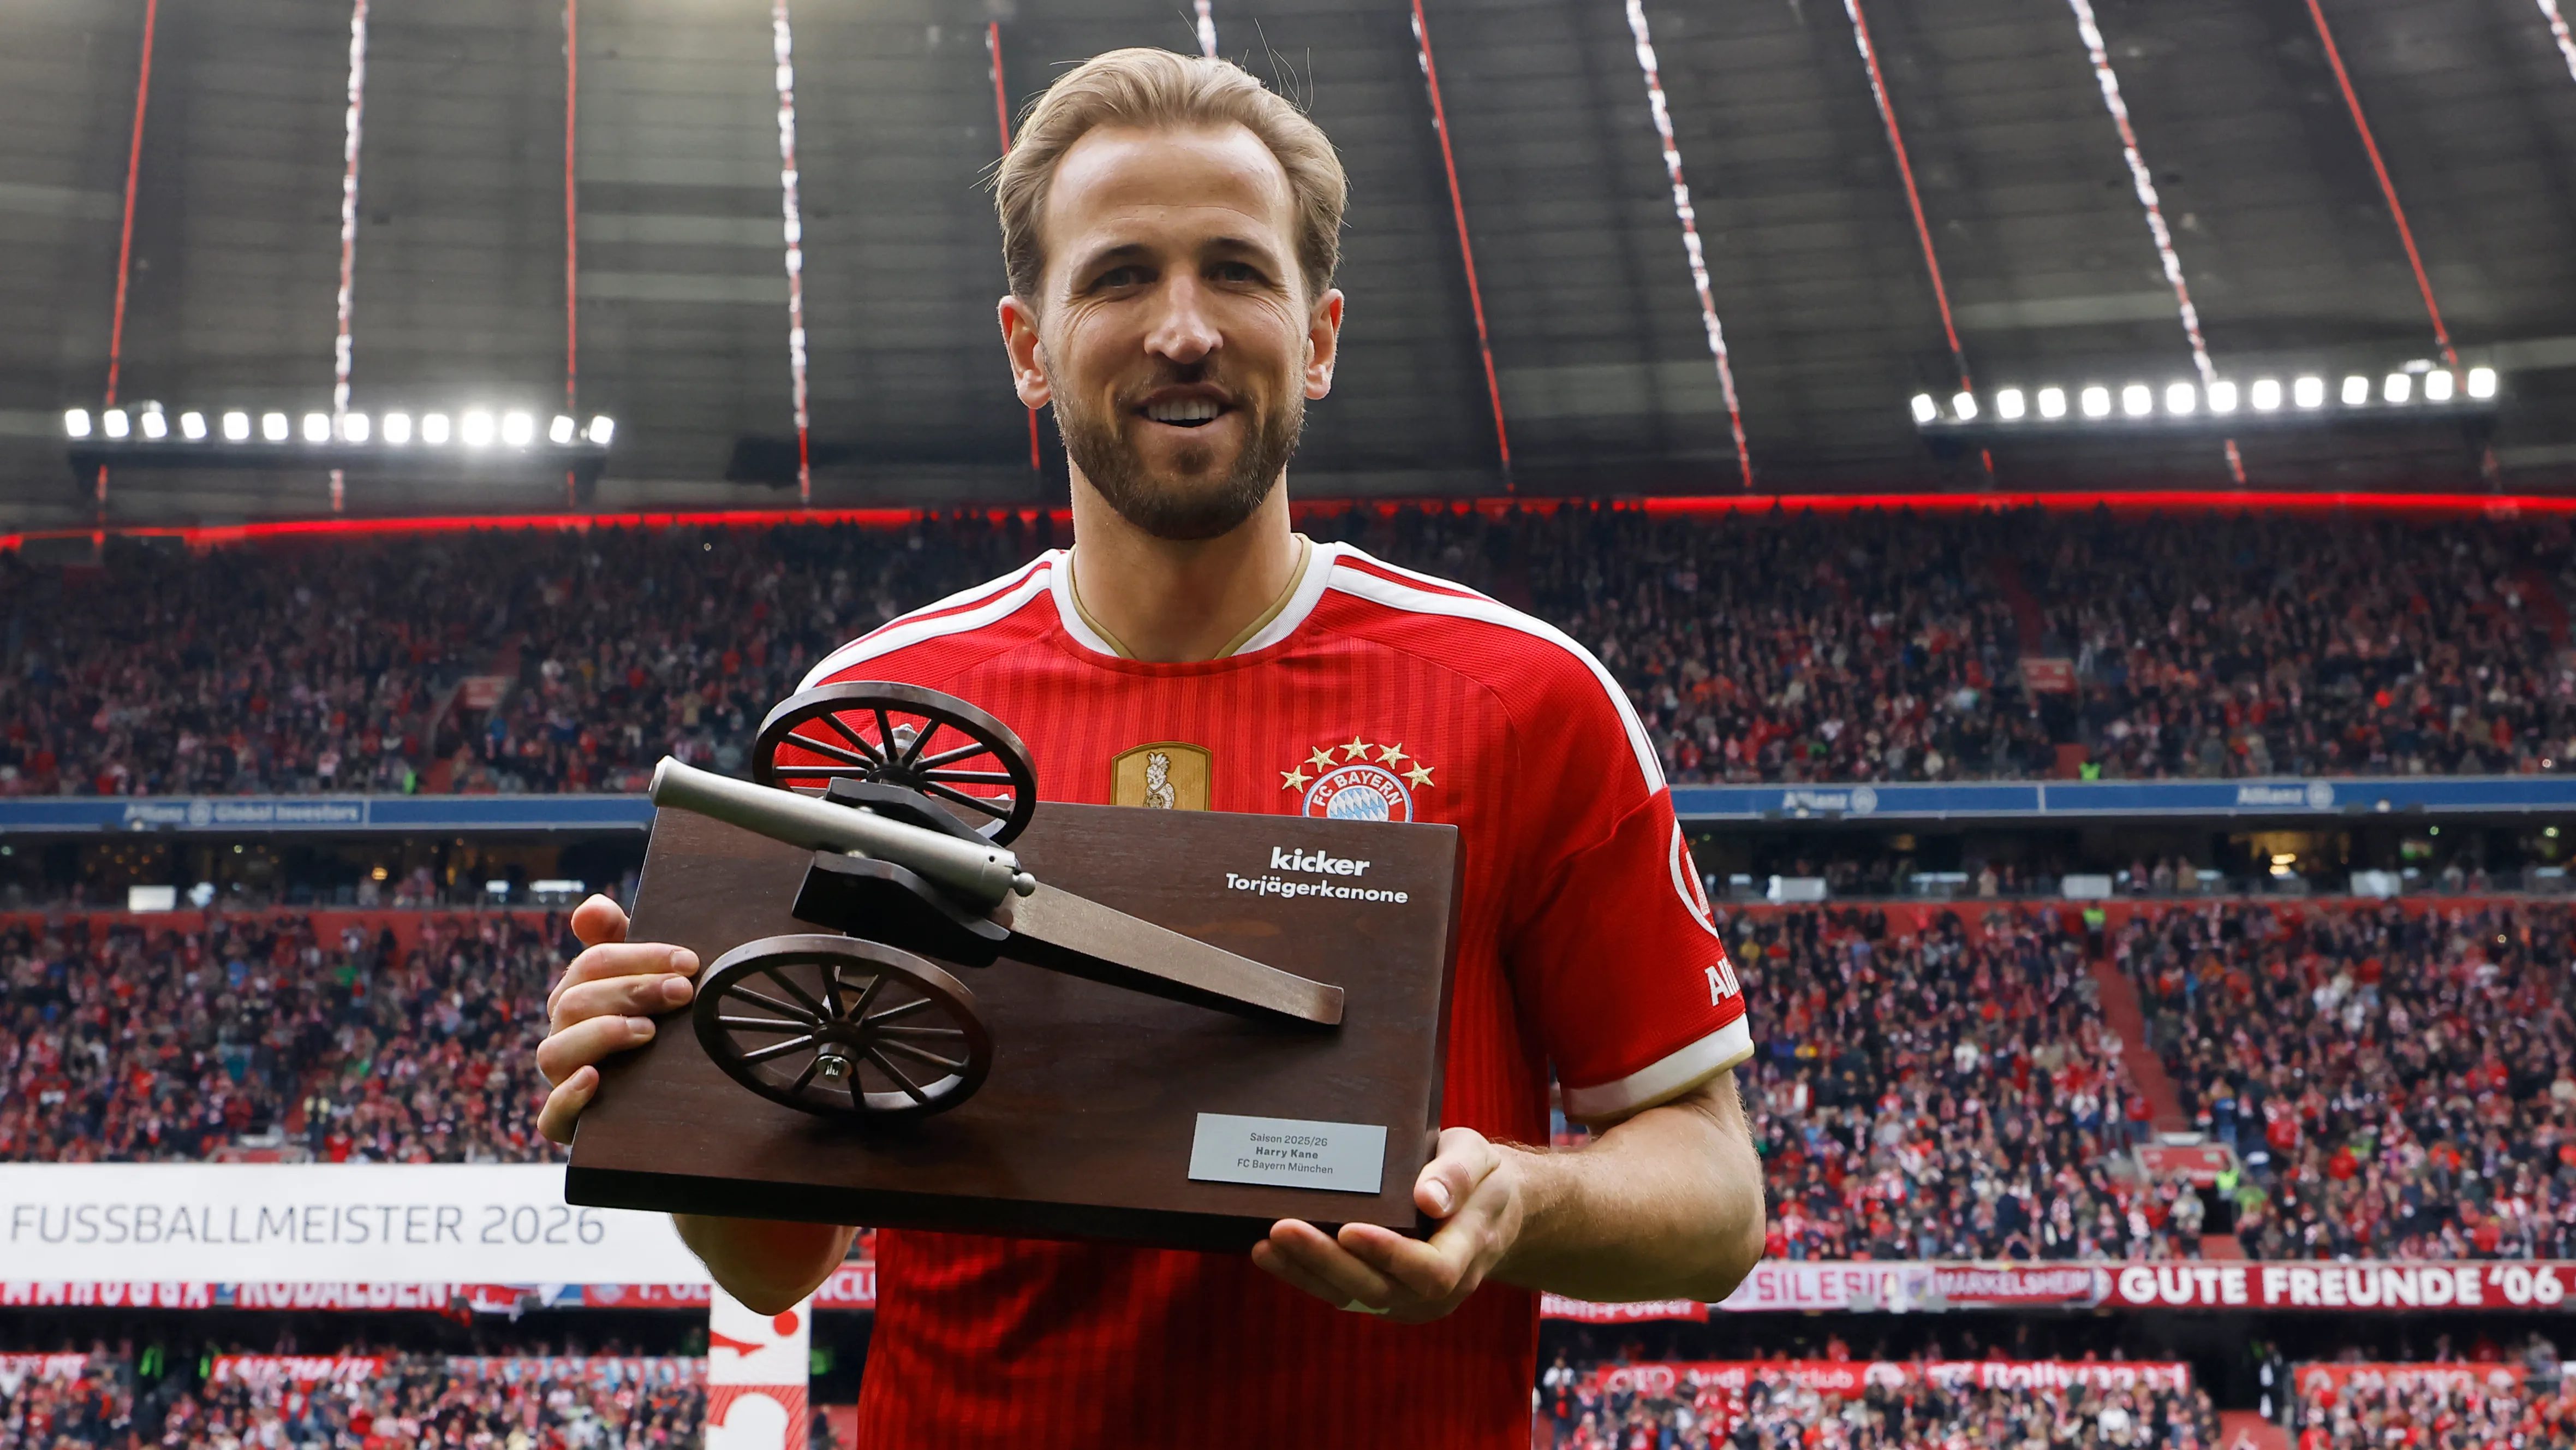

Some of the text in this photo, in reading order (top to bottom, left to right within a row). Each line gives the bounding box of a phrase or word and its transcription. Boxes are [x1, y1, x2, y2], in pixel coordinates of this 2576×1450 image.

[1313, 771, 1403, 806] FC BAYERN
[2237, 786, 2303, 805] Allianz
[1782, 791, 1847, 810] Allianz
[214, 803, 273, 821] Global
[275, 803, 359, 821] Investors
[1269, 846, 1370, 877] kicker
[1225, 873, 1409, 904] Torjägerkanone
[1250, 1133, 1328, 1147] Saison 2025/26
[1255, 1146, 1319, 1159] Harry Kane
[1237, 1159, 1333, 1174] FC Bayern München
[10, 1204, 606, 1244] FUSSBALLMEISTER 2026
[2118, 1268, 2248, 1304] GUTE
[2262, 1267, 2483, 1306] FREUNDE
